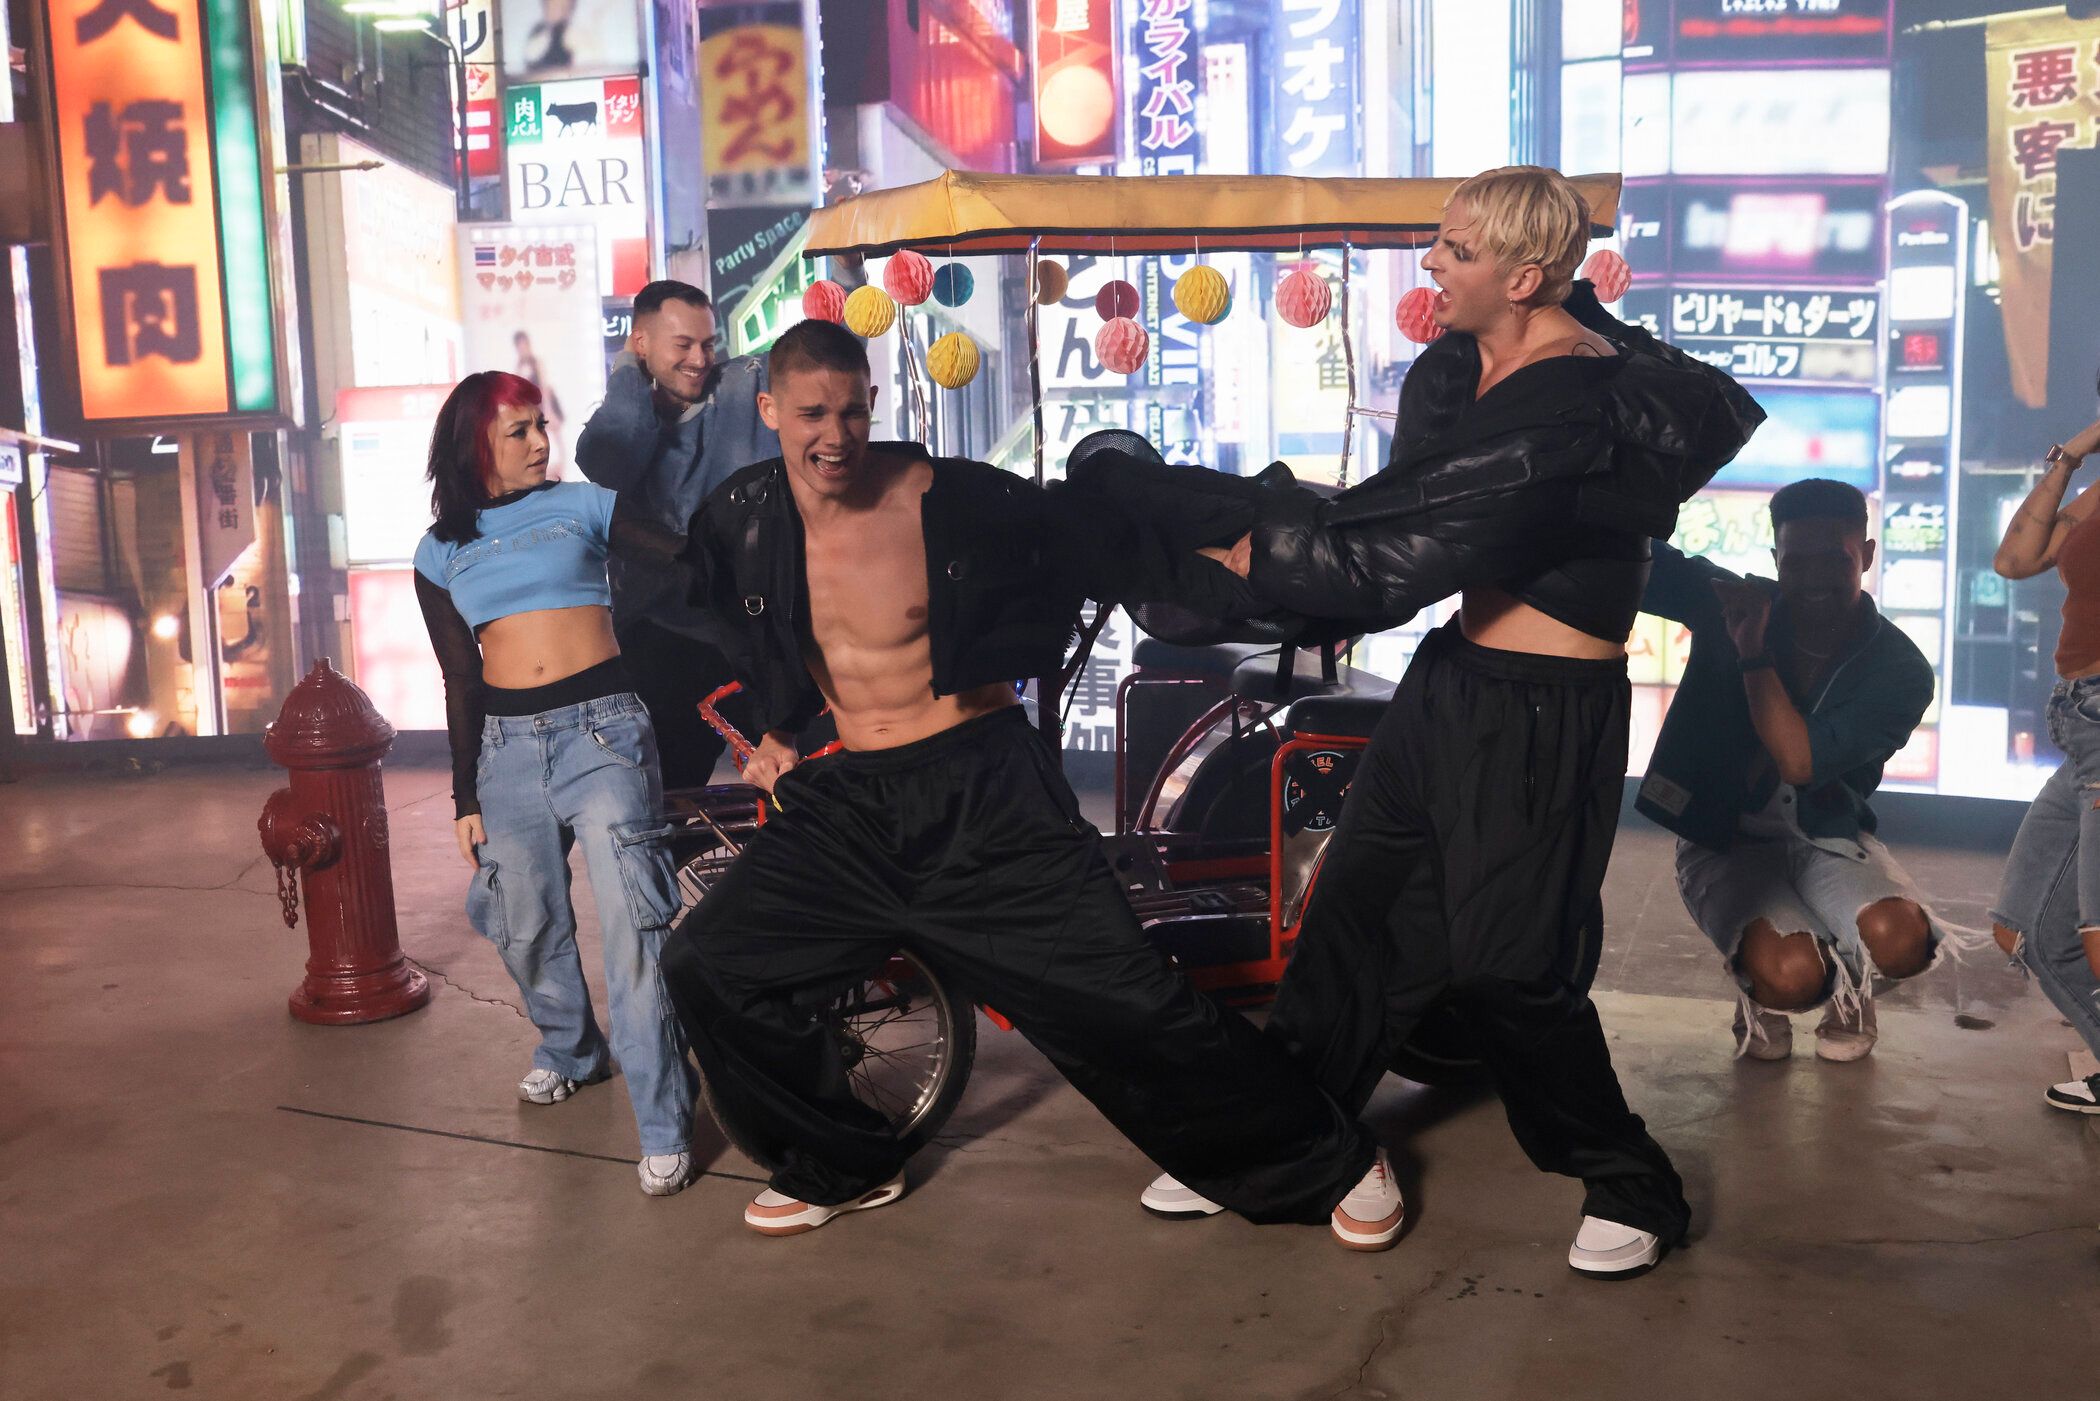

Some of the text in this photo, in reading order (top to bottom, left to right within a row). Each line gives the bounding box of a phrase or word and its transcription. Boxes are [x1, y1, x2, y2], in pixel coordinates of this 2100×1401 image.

[514, 97, 535, 123] 肉
[518, 158, 634, 209] BAR
[715, 211, 803, 275] Party Space
[1147, 261, 1160, 329] INTERNET
[1148, 332, 1161, 386] MAGAZI
